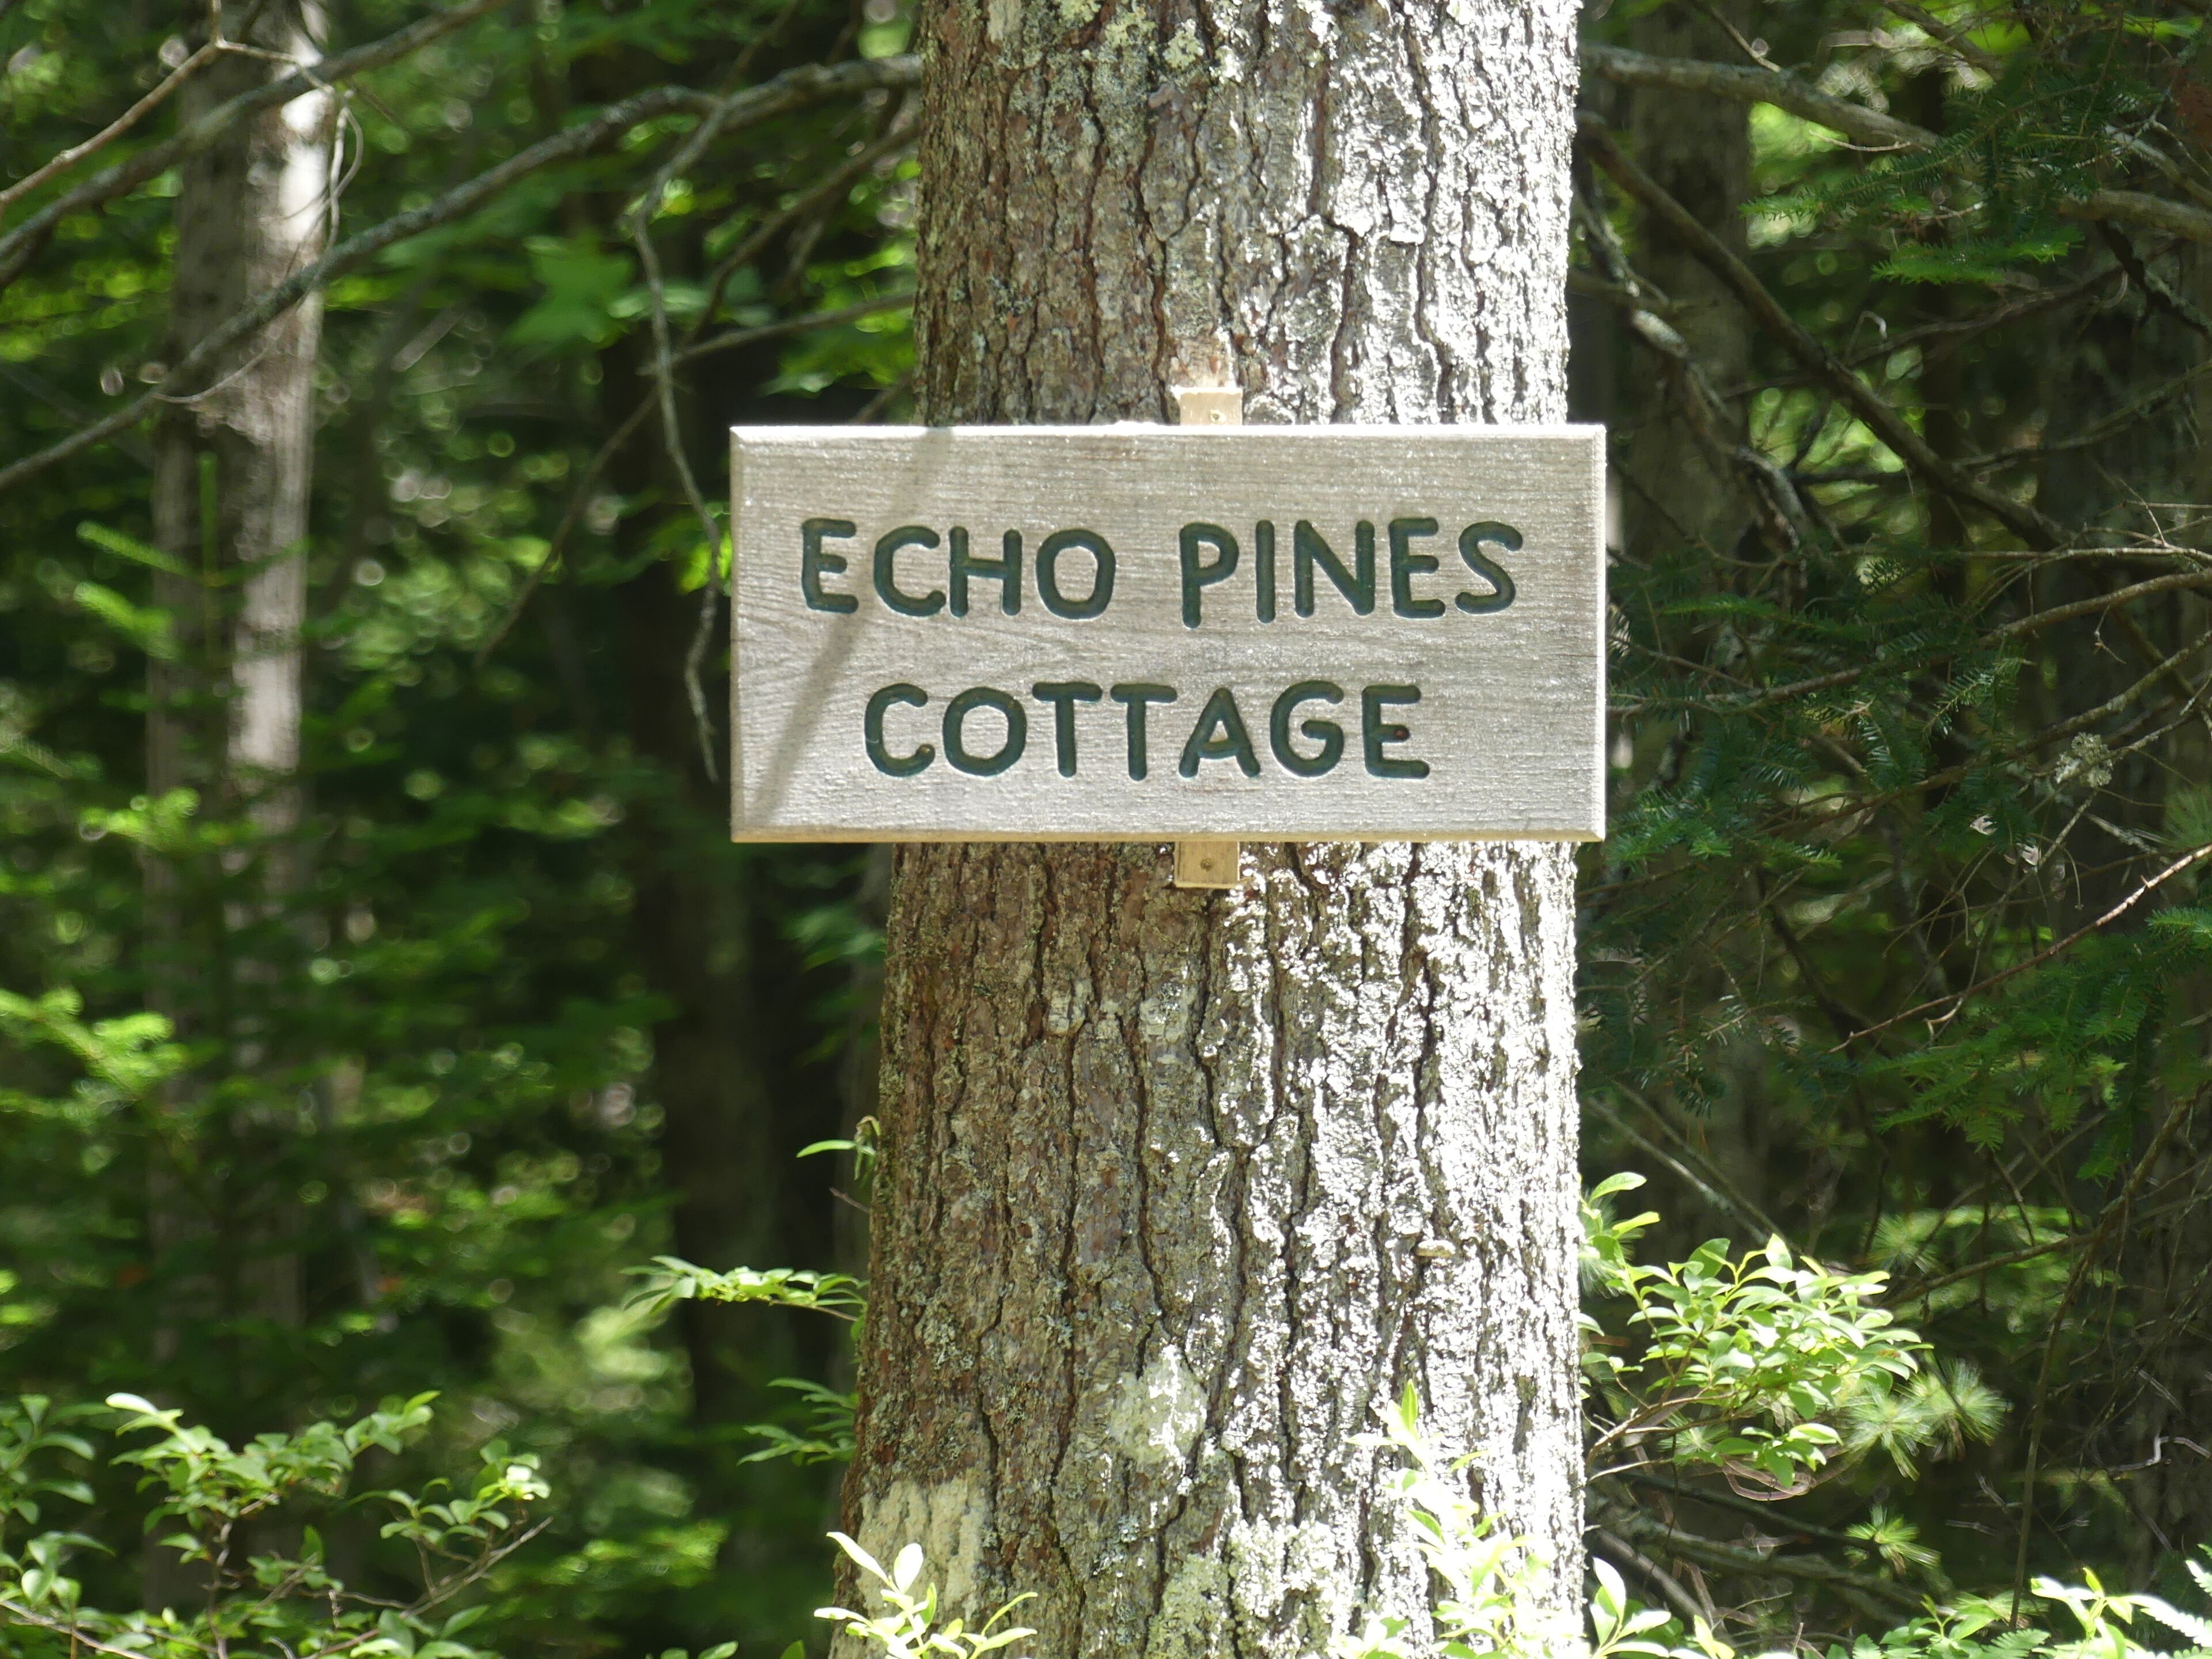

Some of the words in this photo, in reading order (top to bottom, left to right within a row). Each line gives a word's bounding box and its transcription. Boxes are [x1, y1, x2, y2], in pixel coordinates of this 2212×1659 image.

[801, 518, 1116, 620] ECHO
[1178, 517, 1524, 628] PINES
[864, 679, 1430, 781] COTTAGE
